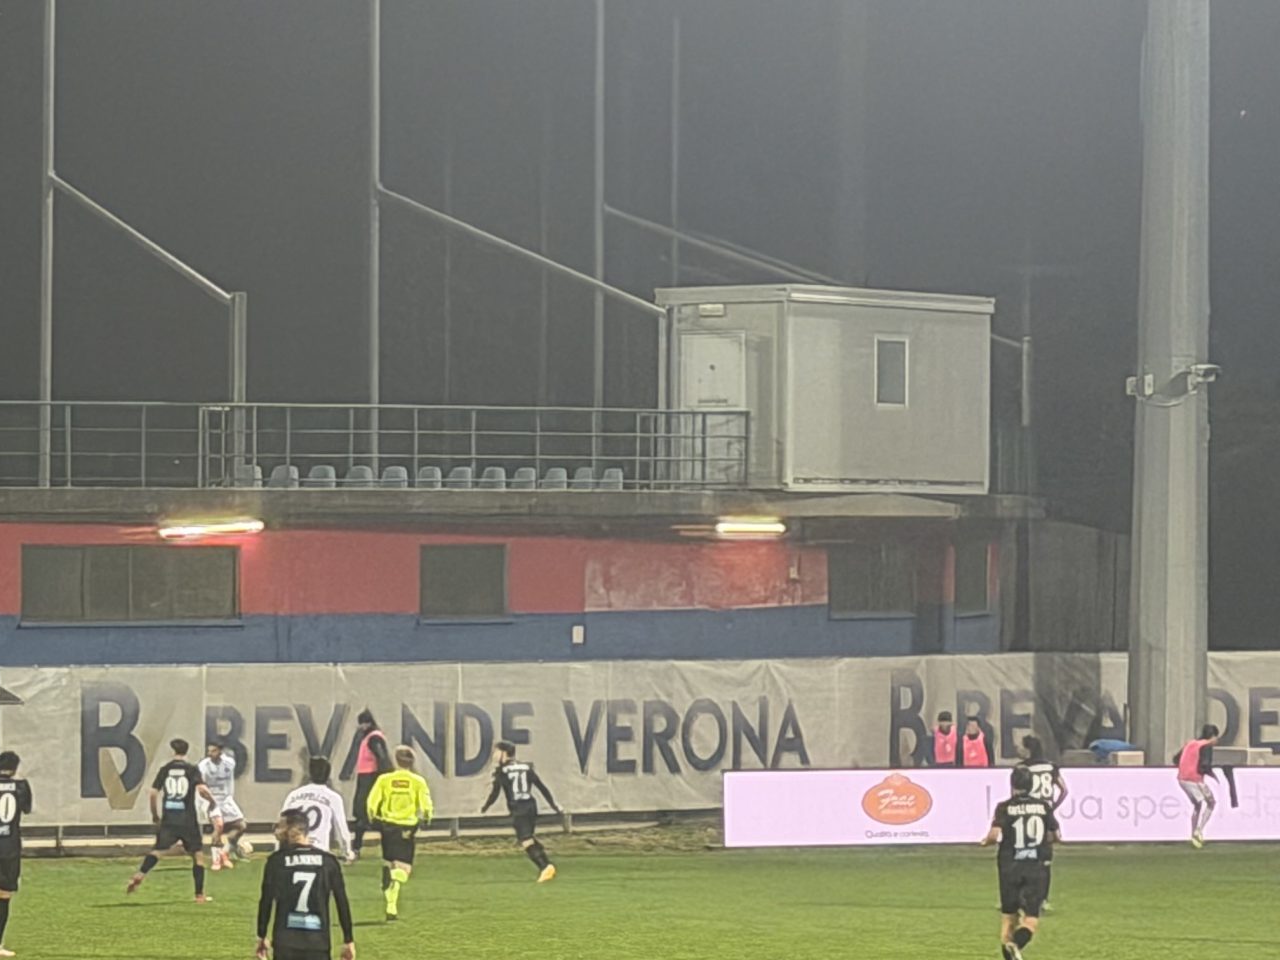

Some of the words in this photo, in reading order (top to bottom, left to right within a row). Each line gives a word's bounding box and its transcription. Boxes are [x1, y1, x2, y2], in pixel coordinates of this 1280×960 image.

[562, 697, 811, 775] VERONA
[165, 776, 189, 799] 99
[508, 771, 528, 794] 71
[1028, 772, 1053, 799] 28
[1012, 815, 1045, 849] 19
[292, 871, 317, 913] 7
